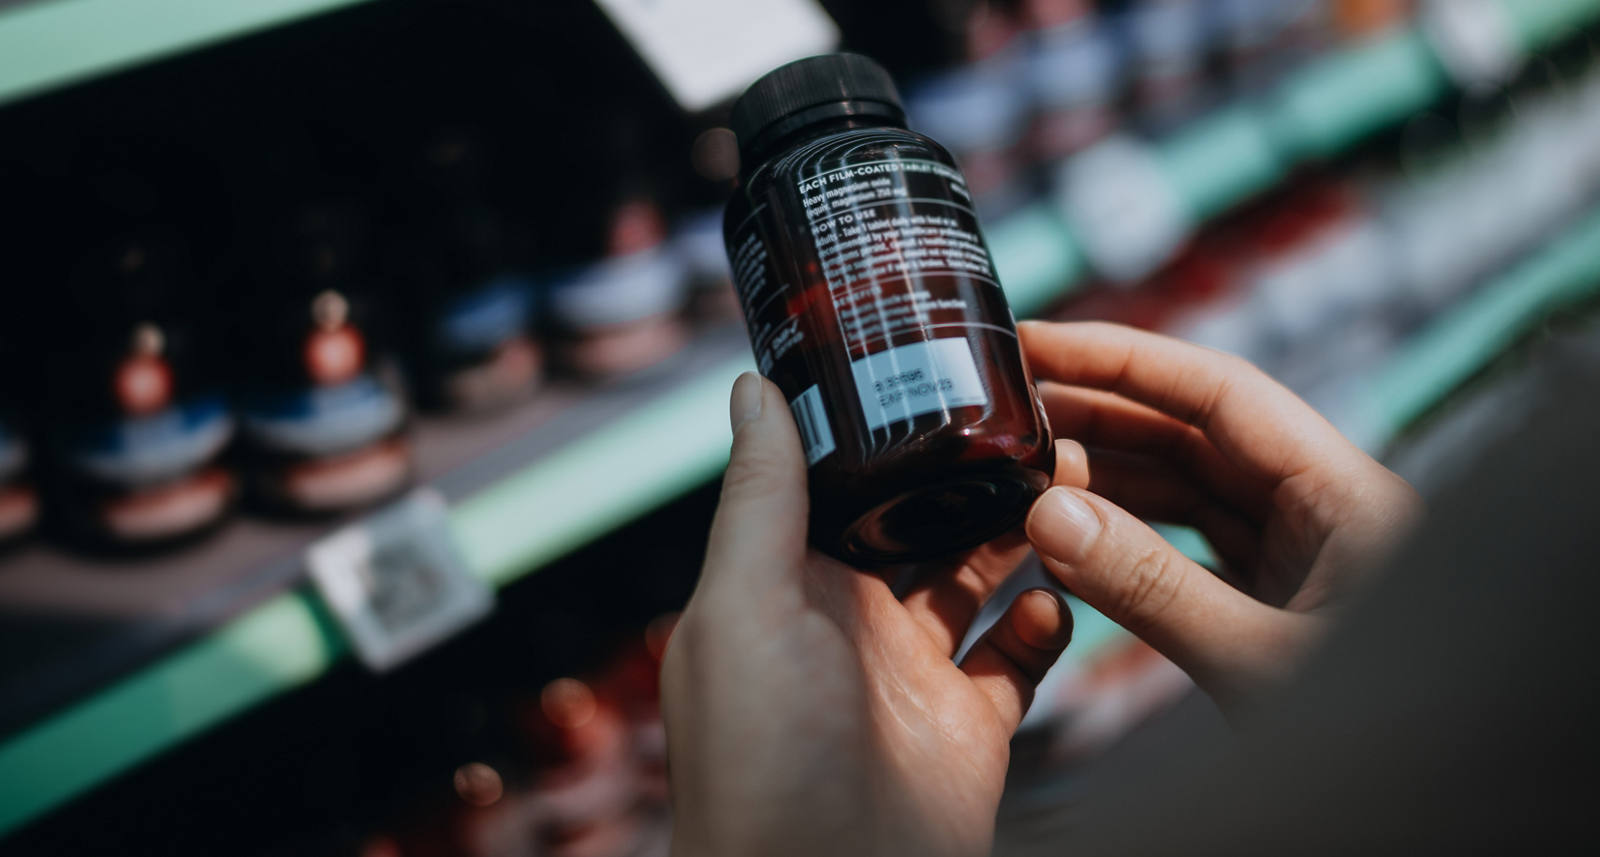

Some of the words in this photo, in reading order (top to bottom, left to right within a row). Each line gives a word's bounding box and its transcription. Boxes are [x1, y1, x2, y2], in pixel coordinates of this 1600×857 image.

[799, 177, 827, 194] EACH
[829, 163, 899, 183] FILM-COATED
[803, 193, 825, 208] Heavy
[826, 181, 870, 199] magnesium
[811, 219, 837, 236] HOW
[838, 214, 853, 226] TO
[854, 208, 876, 221] USE
[842, 226, 861, 238] Take
[867, 219, 891, 232] tablet
